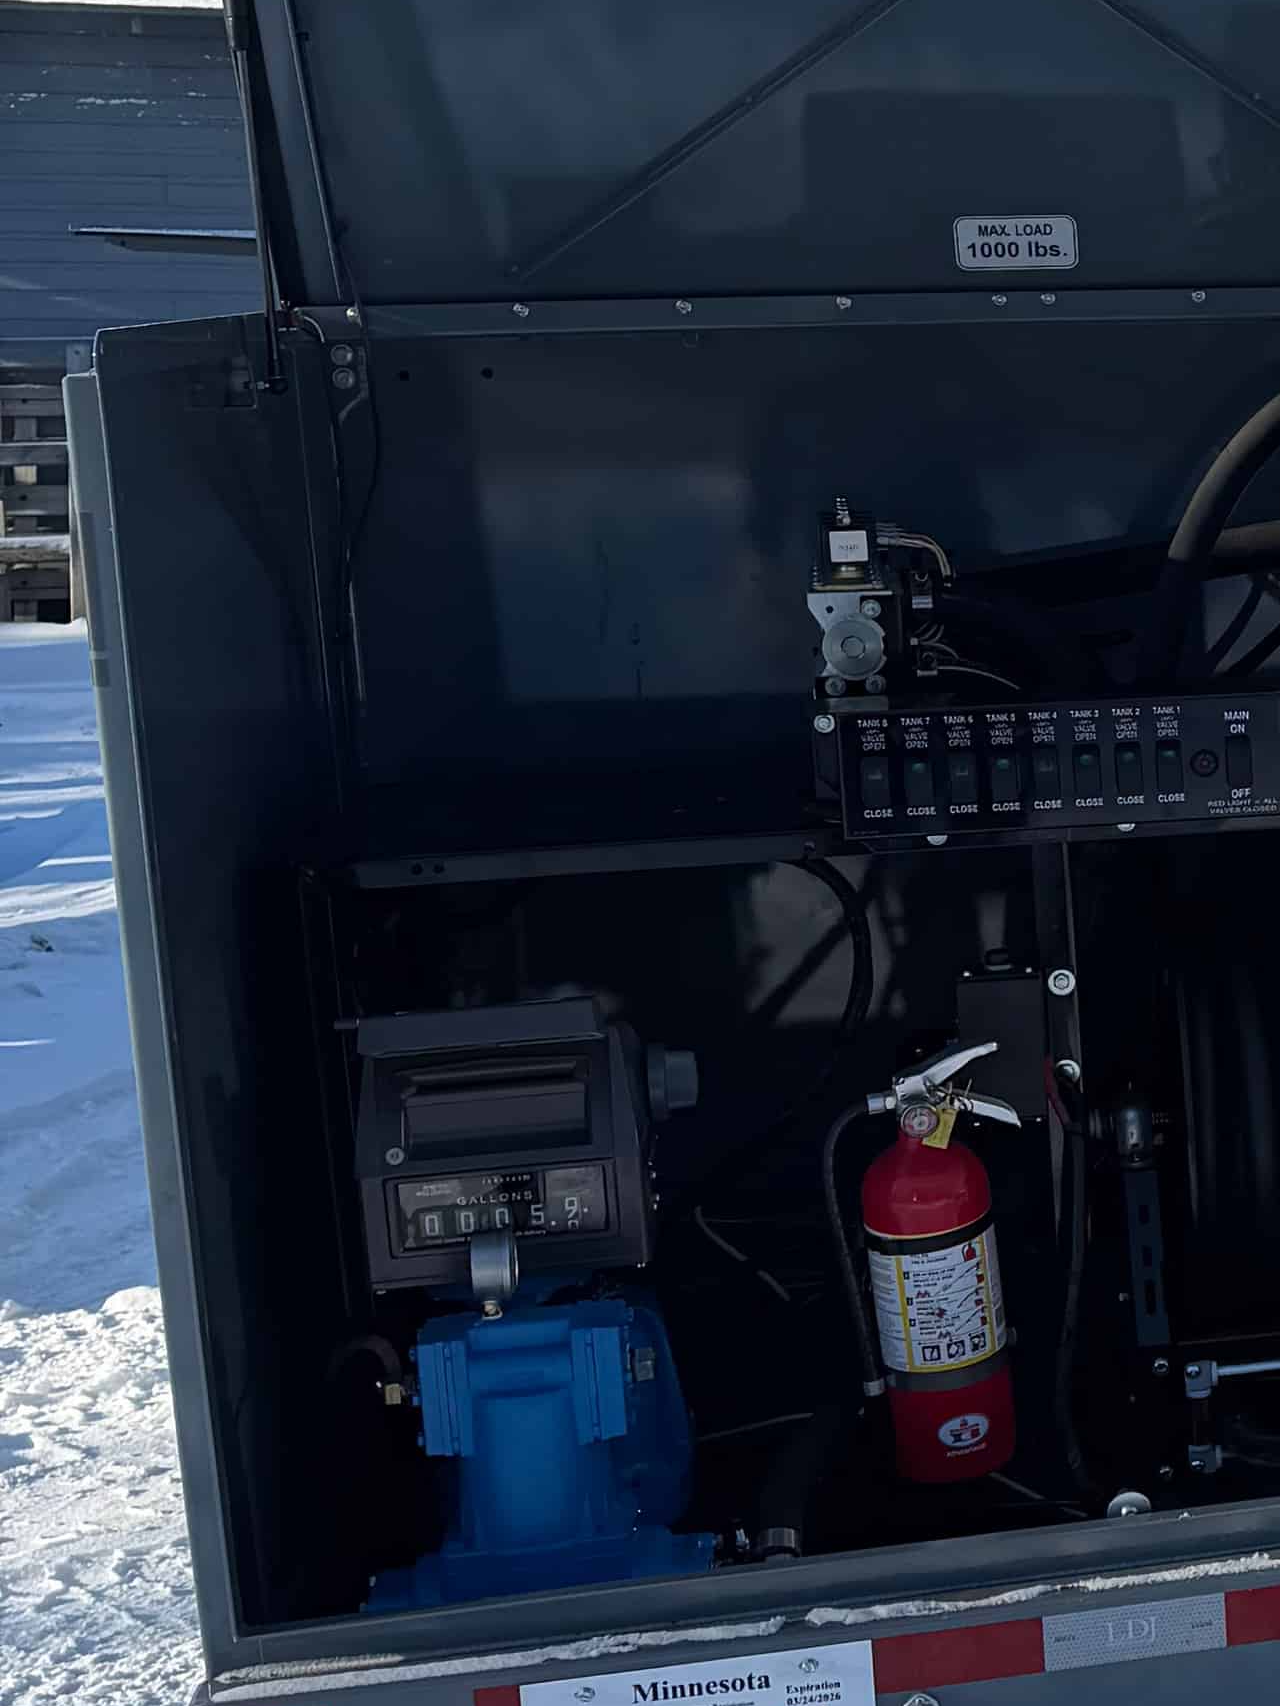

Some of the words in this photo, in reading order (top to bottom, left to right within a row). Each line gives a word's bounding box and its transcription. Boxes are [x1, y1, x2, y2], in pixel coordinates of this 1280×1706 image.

[977, 224, 1011, 237] MAX.
[1015, 223, 1053, 236] LOAD
[967, 242, 1019, 258] 1000
[1028, 241, 1067, 257] lbs.
[1224, 710, 1250, 721] MAIN
[1230, 724, 1246, 734] ON
[1158, 793, 1185, 803] CLOSE
[1231, 788, 1251, 798] OFF
[1033, 799, 1063, 810] CLOSE
[1075, 797, 1104, 807] CLOSE
[1116, 795, 1144, 805] CLOSE
[906, 806, 936, 816] CLOSE
[949, 805, 979, 814] CLOSE
[992, 802, 1021, 812] CLOSE
[864, 808, 893, 818] CLOSE
[456, 1189, 533, 1206] GALLONS
[631, 1671, 771, 1704] Minnesota
[786, 1680, 841, 1696] Expiration
